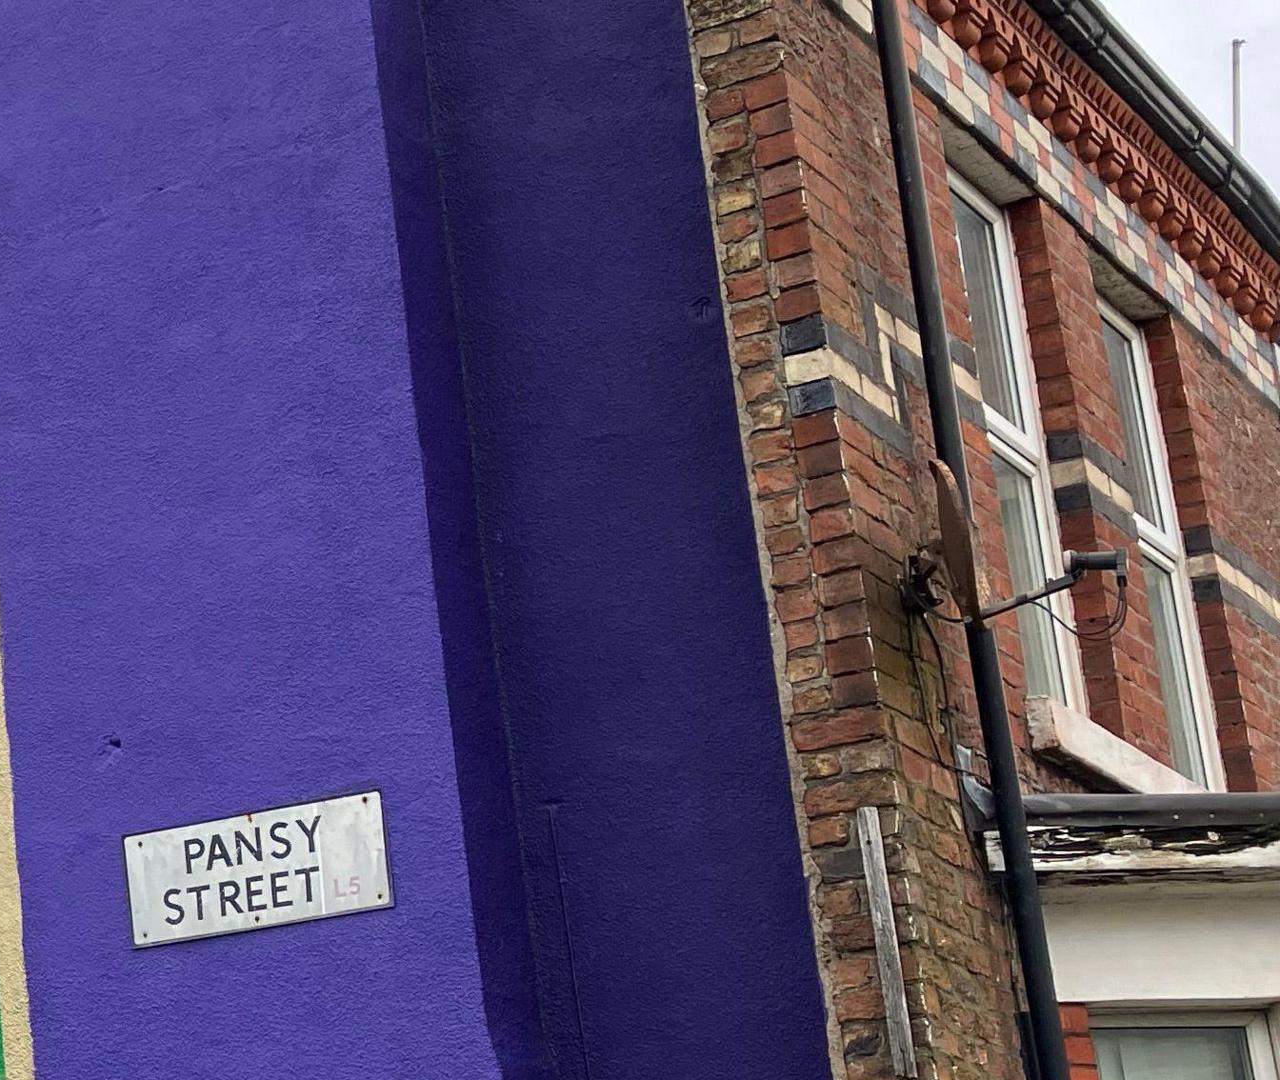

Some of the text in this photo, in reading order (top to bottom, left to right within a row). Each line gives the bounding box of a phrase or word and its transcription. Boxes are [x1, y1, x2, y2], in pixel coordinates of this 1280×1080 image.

[183, 815, 322, 875] PANSY
[162, 866, 361, 926] STREET L5
